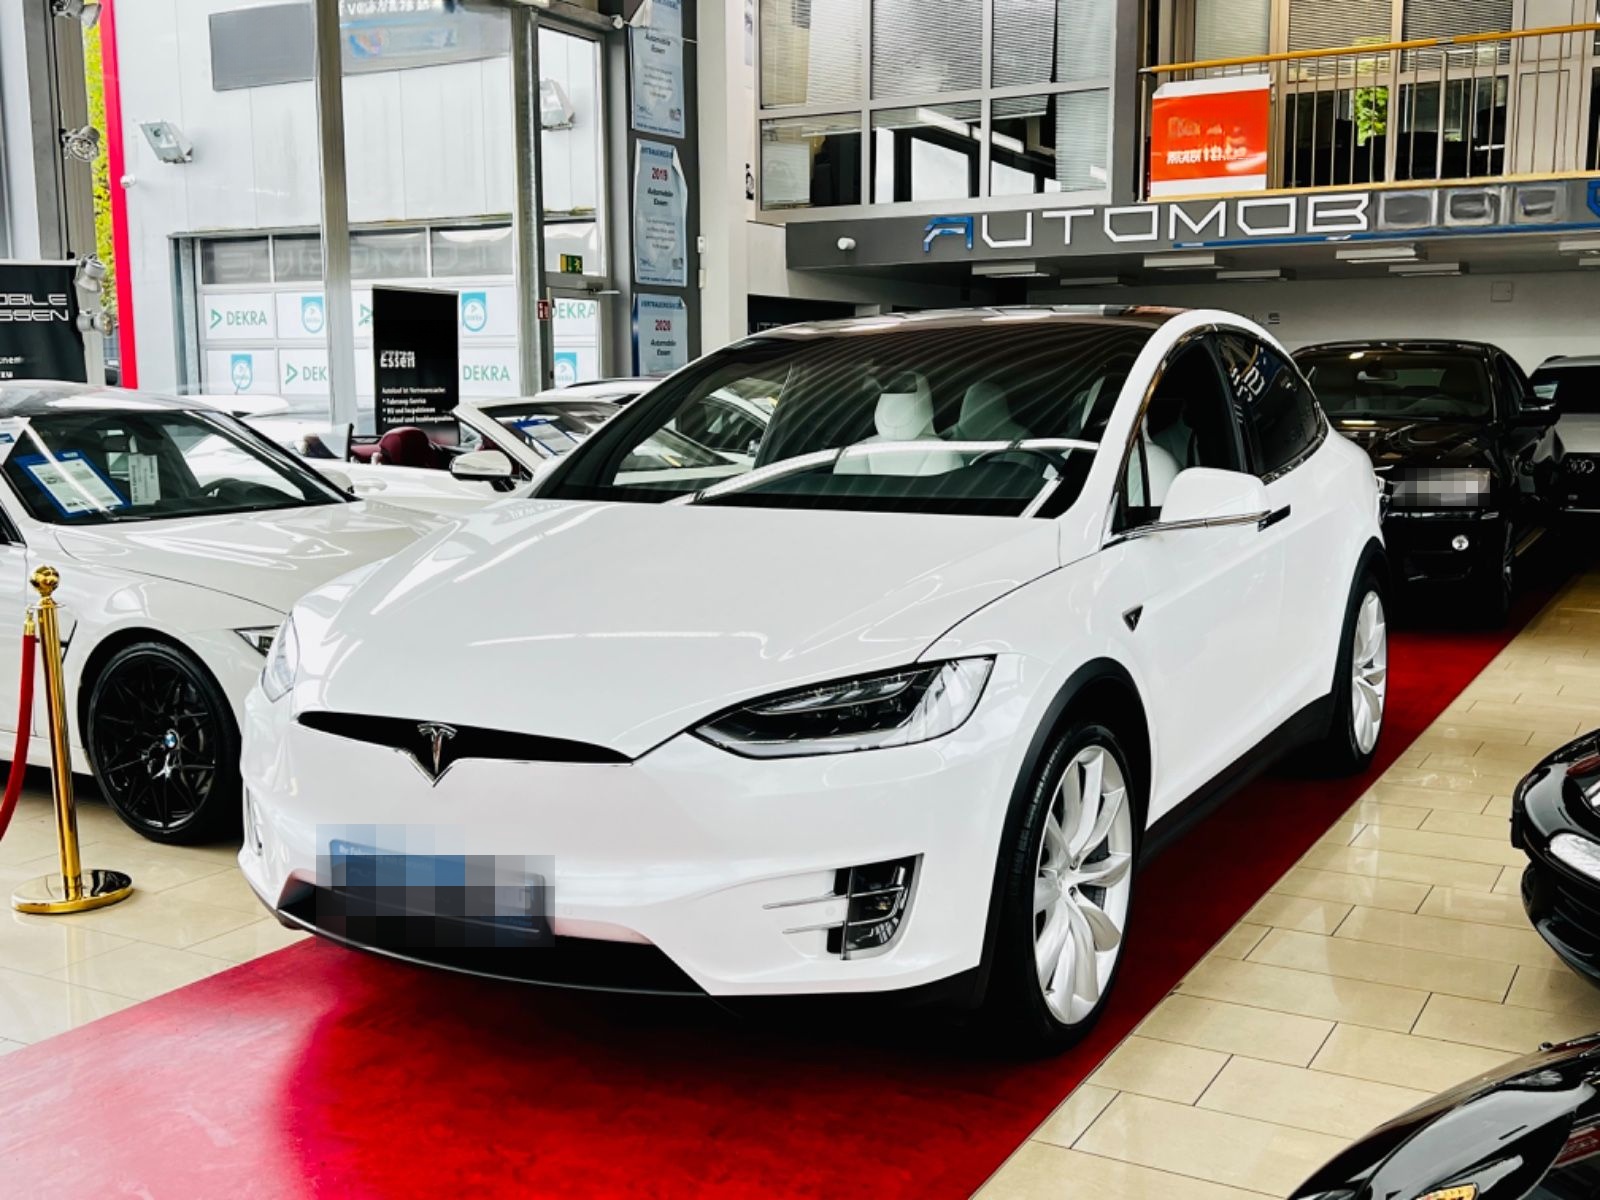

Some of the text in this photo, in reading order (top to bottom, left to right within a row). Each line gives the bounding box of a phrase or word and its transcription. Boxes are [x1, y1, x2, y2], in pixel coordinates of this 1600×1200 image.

[226, 310, 268, 326] DEKRA
[302, 365, 328, 382] DEK
[463, 365, 511, 382] DEKRA
